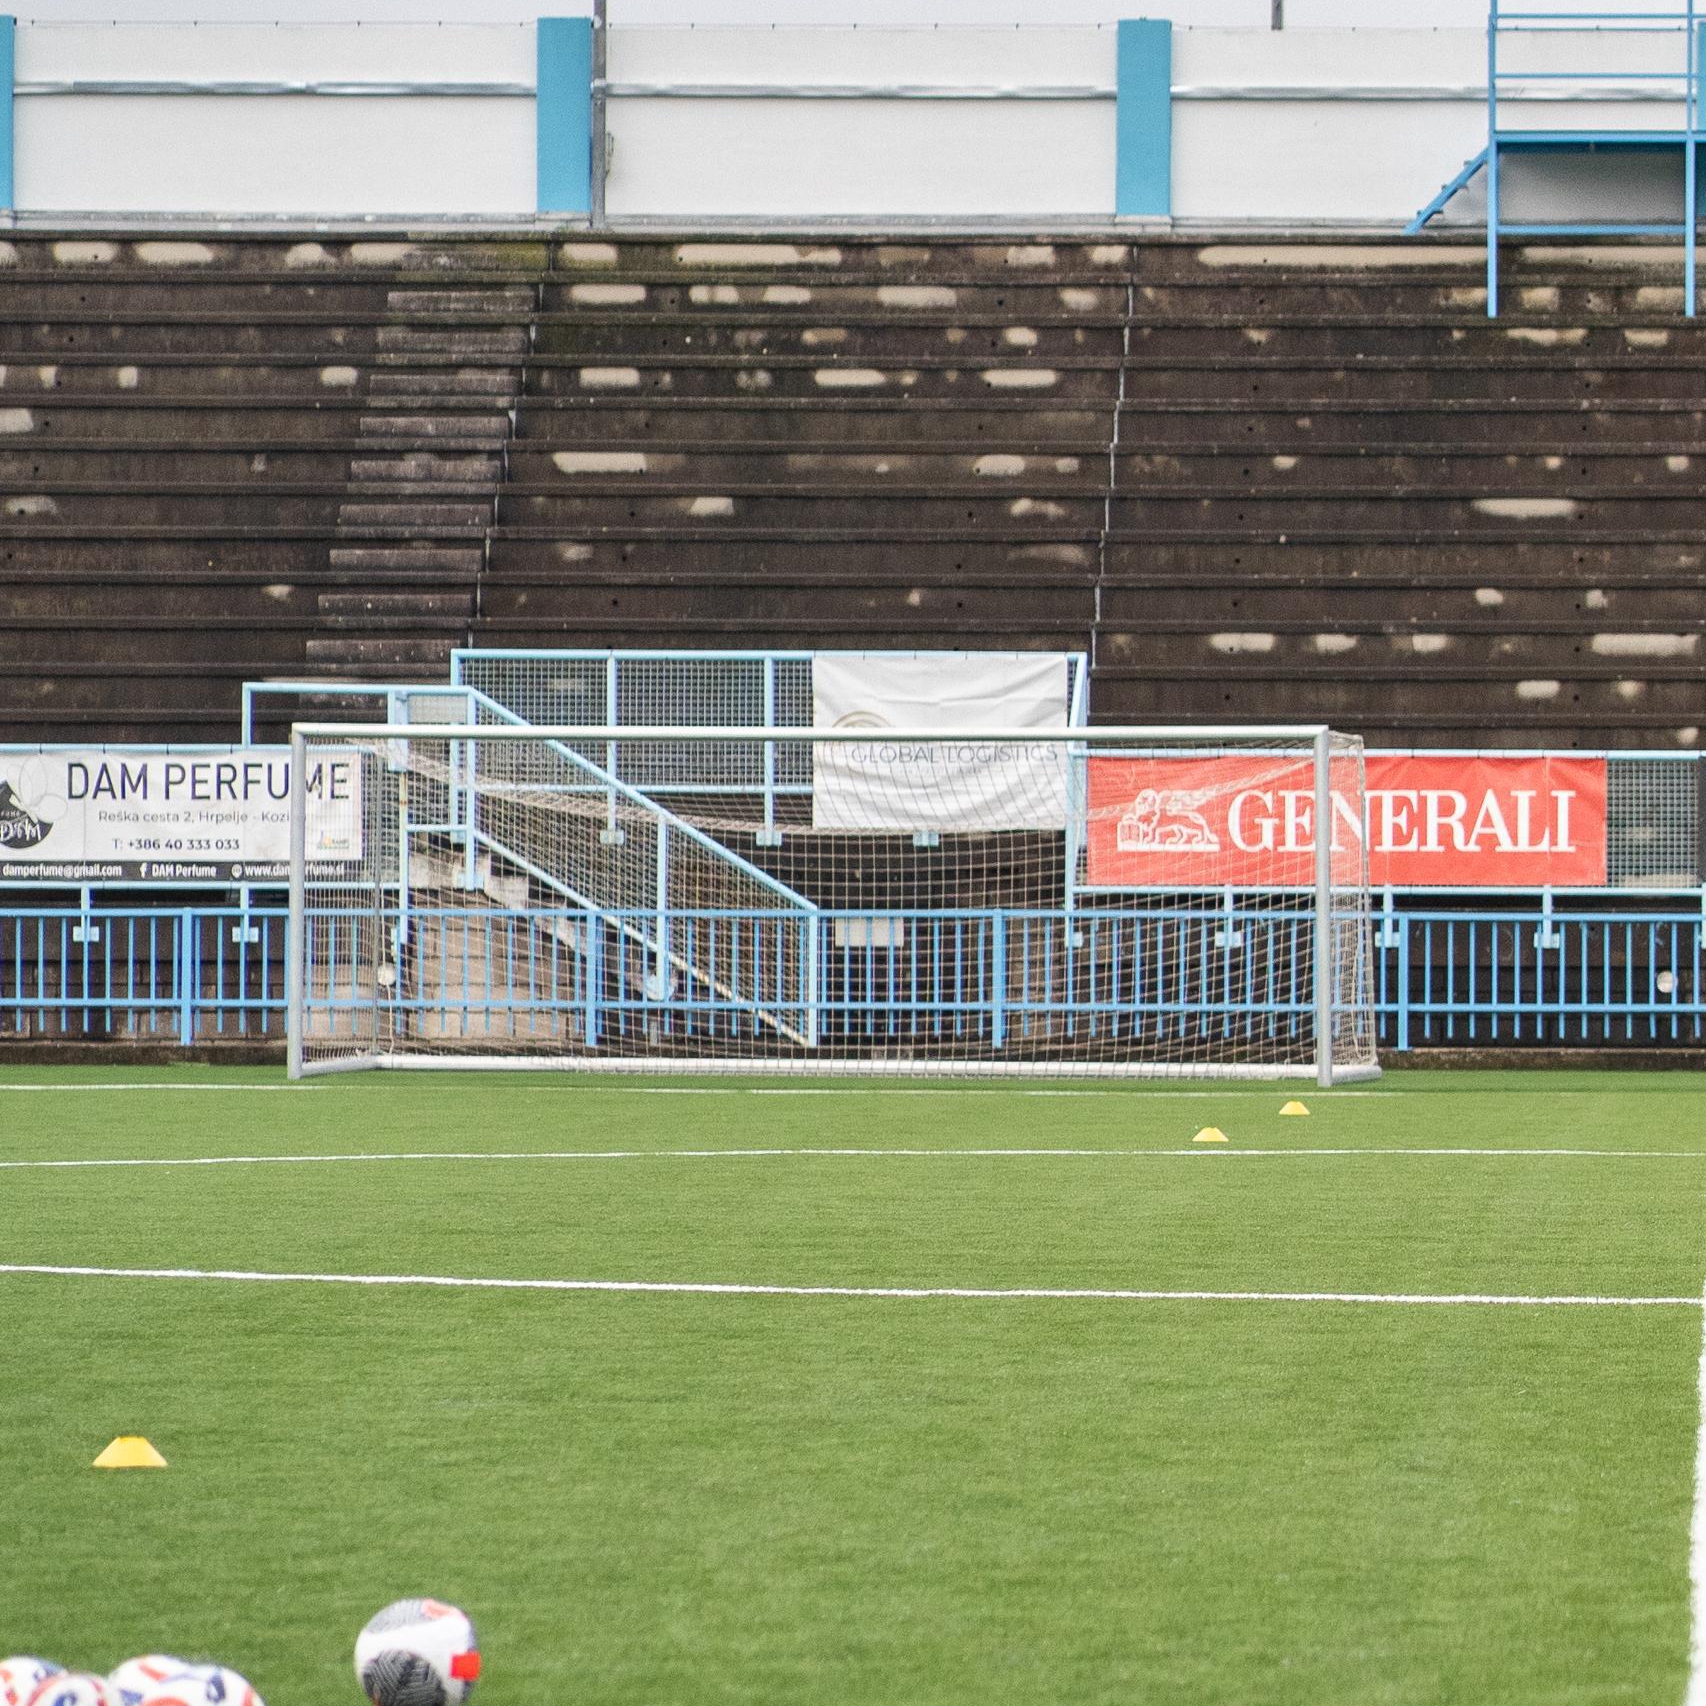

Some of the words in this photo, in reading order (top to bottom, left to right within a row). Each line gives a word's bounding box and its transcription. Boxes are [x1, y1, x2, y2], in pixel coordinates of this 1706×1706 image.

[851, 744, 939, 764] GLOBAL
[947, 743, 1058, 764] LOGISTICS
[67, 762, 148, 800] DAM
[165, 762, 350, 800] PERFUME
[143, 811, 180, 822] cesta
[1227, 789, 1576, 853] GENERALI
[127, 838, 161, 850] +386
[164, 838, 183, 850] 40
[186, 838, 213, 850] 333
[215, 838, 240, 850] 033
[2, 862, 122, 877] damperfume@gmail.com
[151, 863, 175, 876] DAM
[175, 863, 217, 877] Perfume
